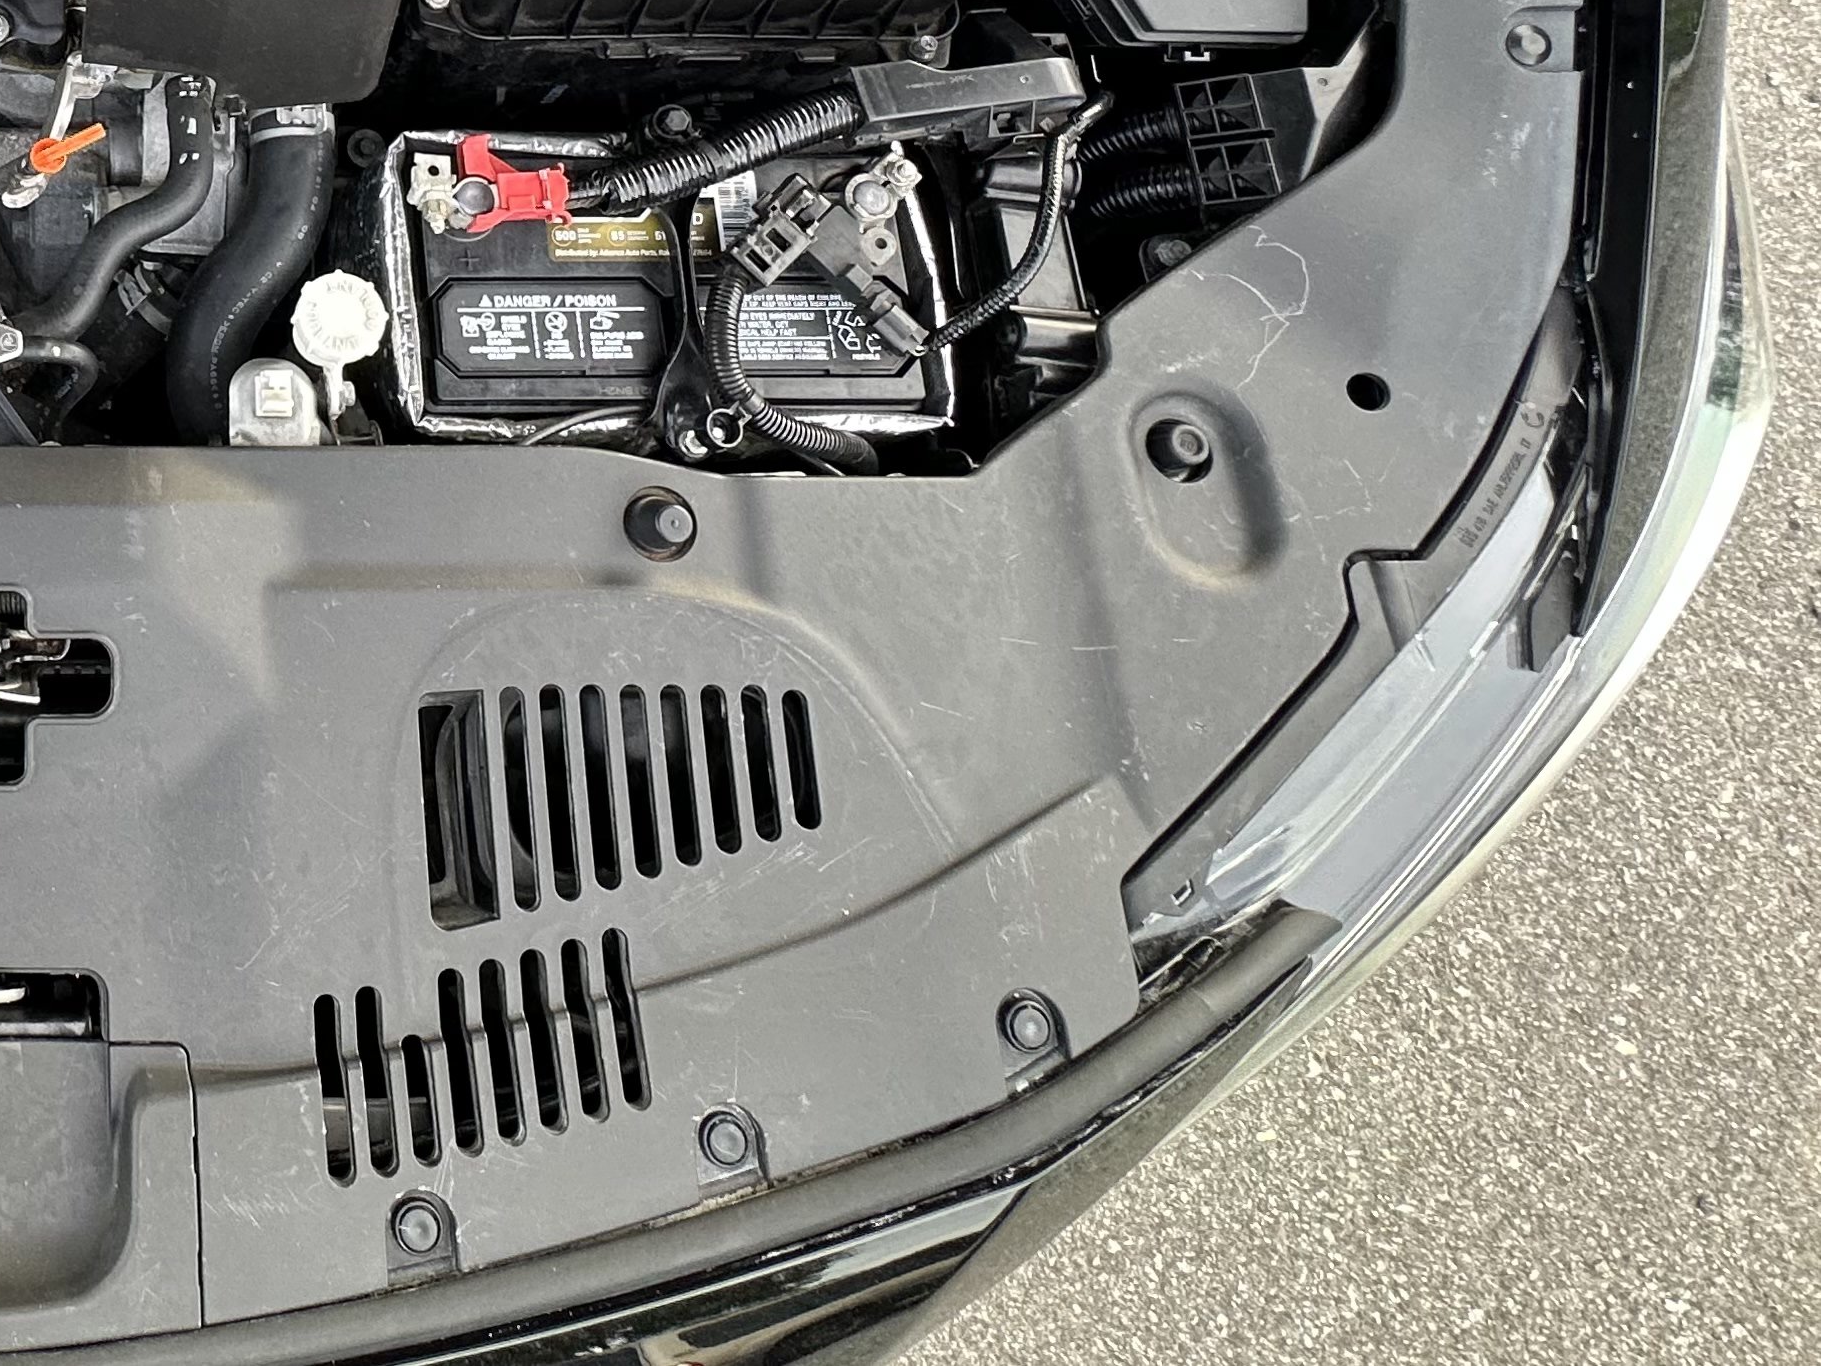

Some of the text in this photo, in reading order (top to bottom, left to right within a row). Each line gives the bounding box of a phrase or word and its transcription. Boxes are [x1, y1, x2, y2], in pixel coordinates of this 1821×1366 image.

[554, 230, 577, 241] 500
[625, 249, 640, 257] Auto
[493, 293, 618, 308] DANGER / POISON
[750, 312, 816, 321] EYES IMMEDIATELY
[760, 328, 778, 336] HELP
